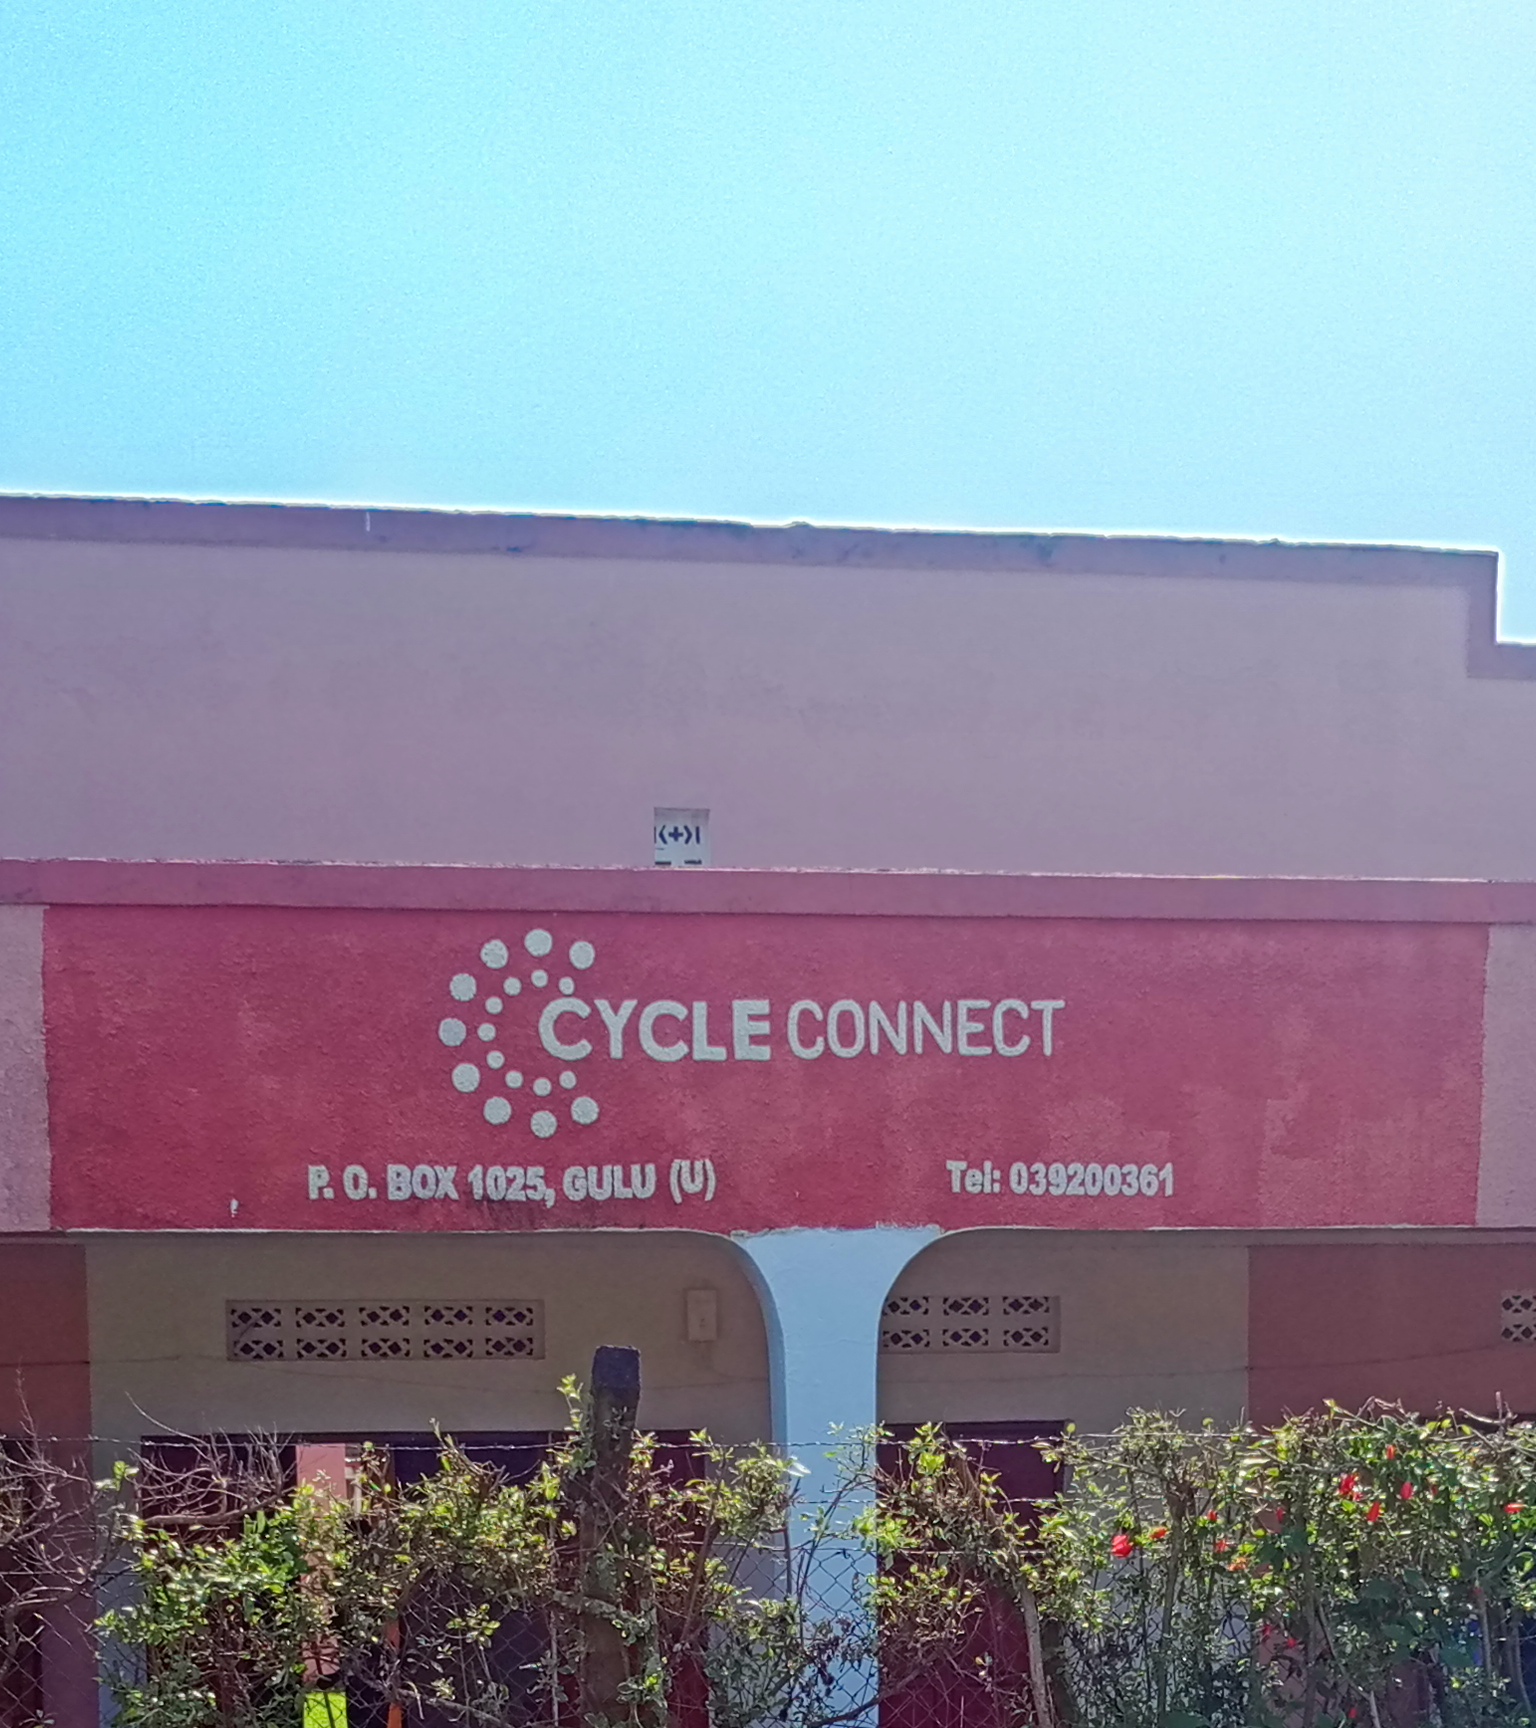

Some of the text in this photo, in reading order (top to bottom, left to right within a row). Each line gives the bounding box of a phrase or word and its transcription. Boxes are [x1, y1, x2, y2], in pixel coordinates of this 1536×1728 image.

[538, 997, 1065, 1062] CYCLE CONNECT
[342, 1165, 377, 1200] O.
[387, 1164, 460, 1200] BOX
[468, 1164, 556, 1208] 1025,
[564, 1163, 656, 1200] GULU
[669, 1158, 716, 1204] (U)
[946, 1160, 1174, 1197] Tel: 039200361
